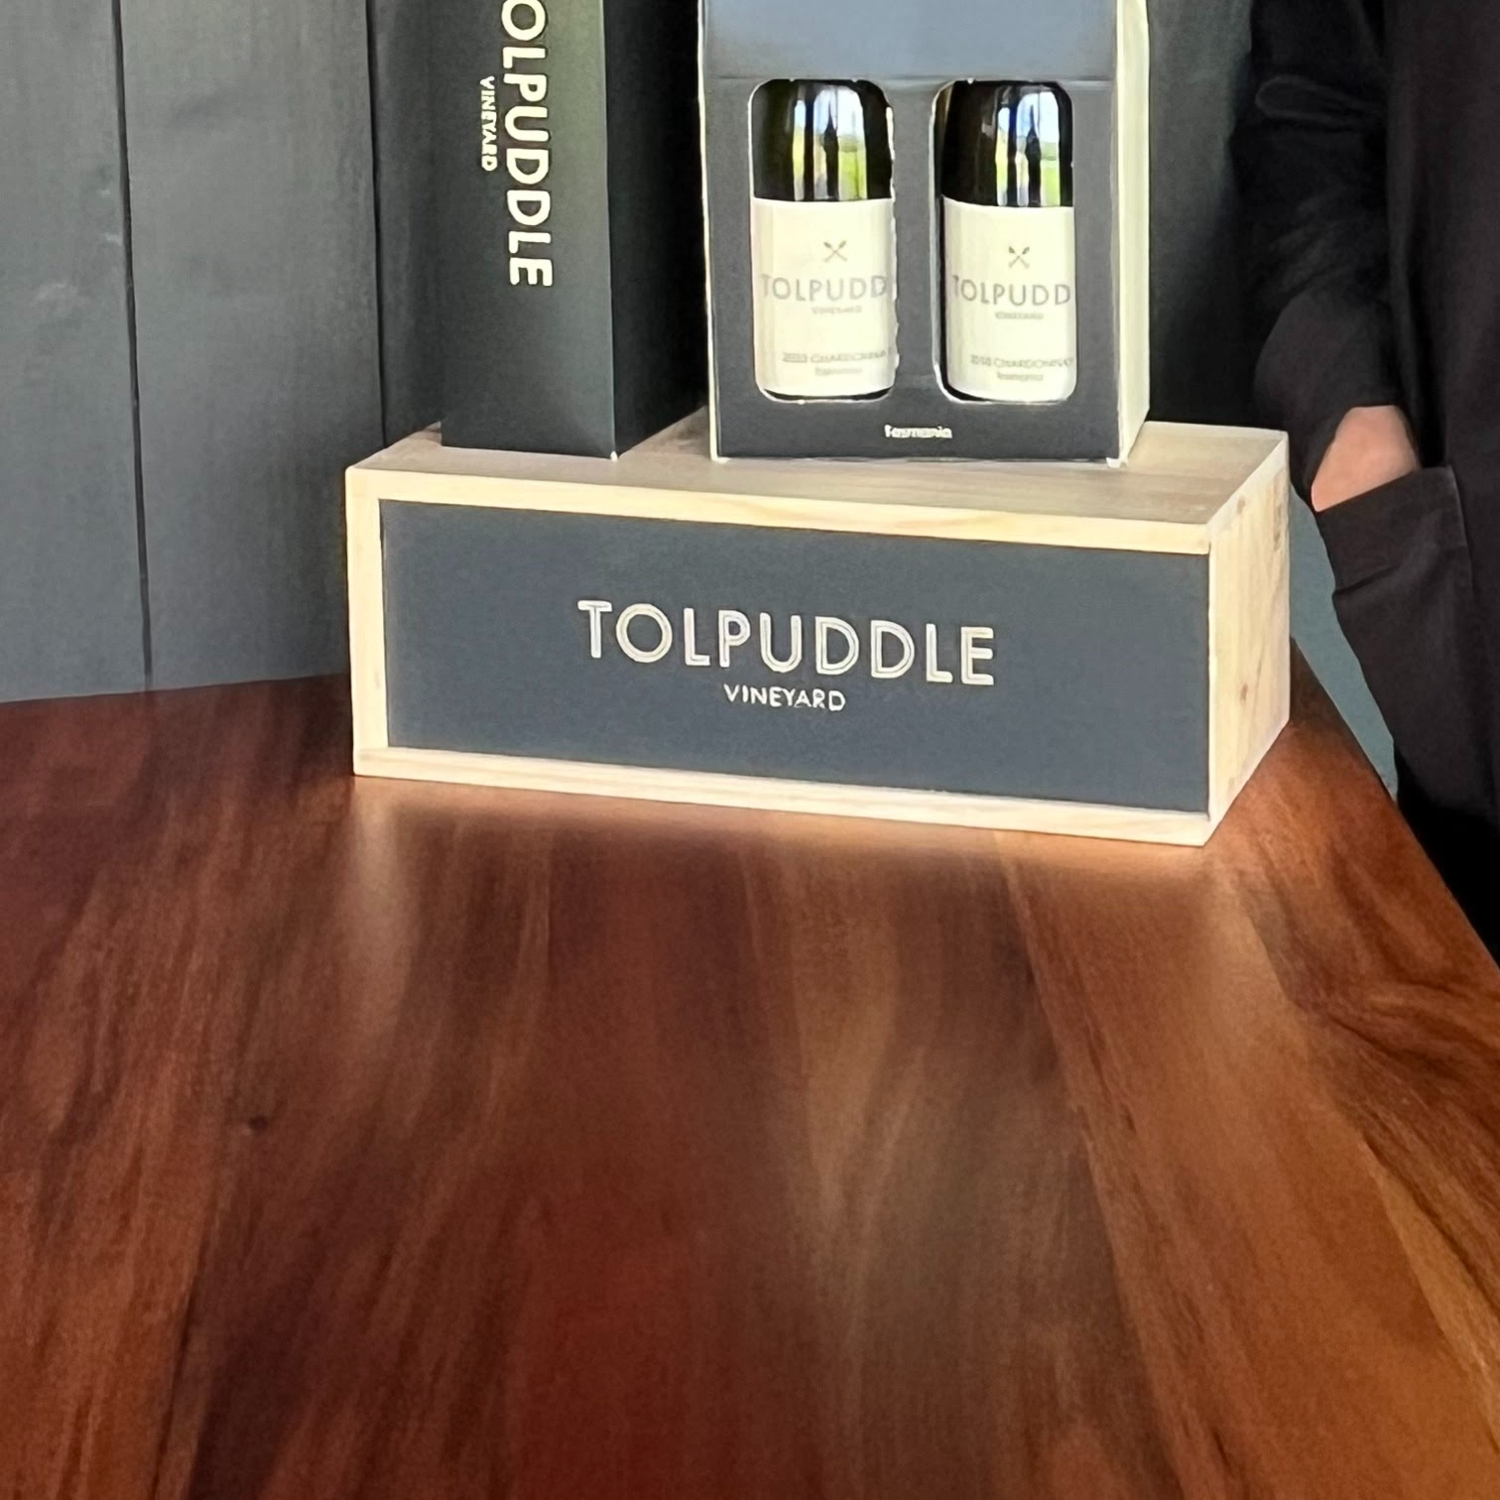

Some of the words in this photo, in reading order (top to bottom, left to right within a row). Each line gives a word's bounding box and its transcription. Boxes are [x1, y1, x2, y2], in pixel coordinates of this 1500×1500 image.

[479, 75, 498, 172] VINEYARD
[577, 600, 995, 686] TOLPUDDLE
[723, 683, 846, 712] VINEYARD
